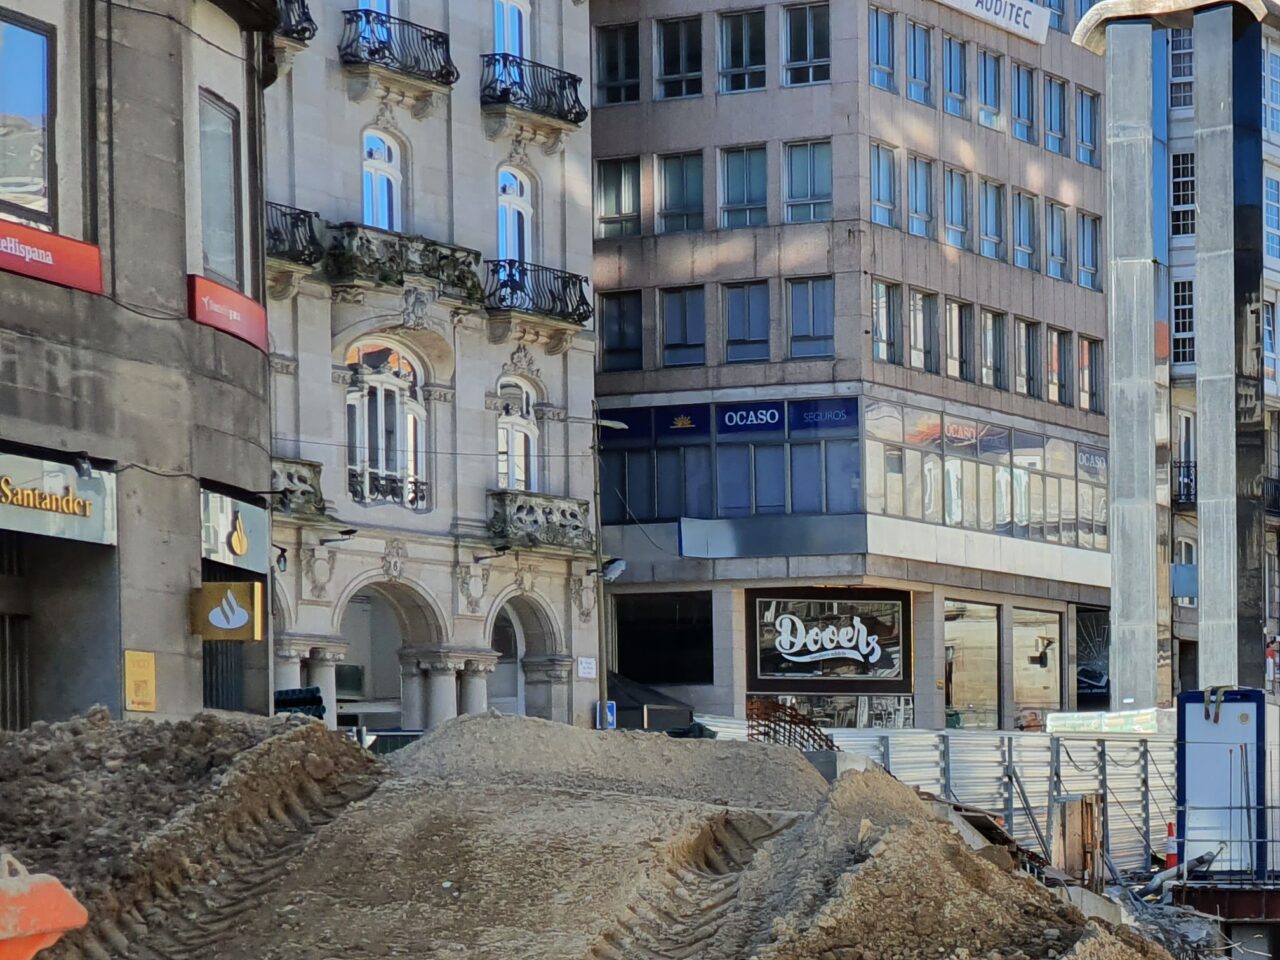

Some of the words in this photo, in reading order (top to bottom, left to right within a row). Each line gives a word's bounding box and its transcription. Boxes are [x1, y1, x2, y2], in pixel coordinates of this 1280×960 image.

[975, 0, 1032, 29] AUDITEC
[724, 409, 779, 426] OCASO
[803, 409, 847, 423] SEGUROS
[944, 425, 976, 439] OCASO
[1078, 452, 1106, 469] OCASO
[0, 476, 92, 517] Santander
[775, 613, 882, 663] Dooers
